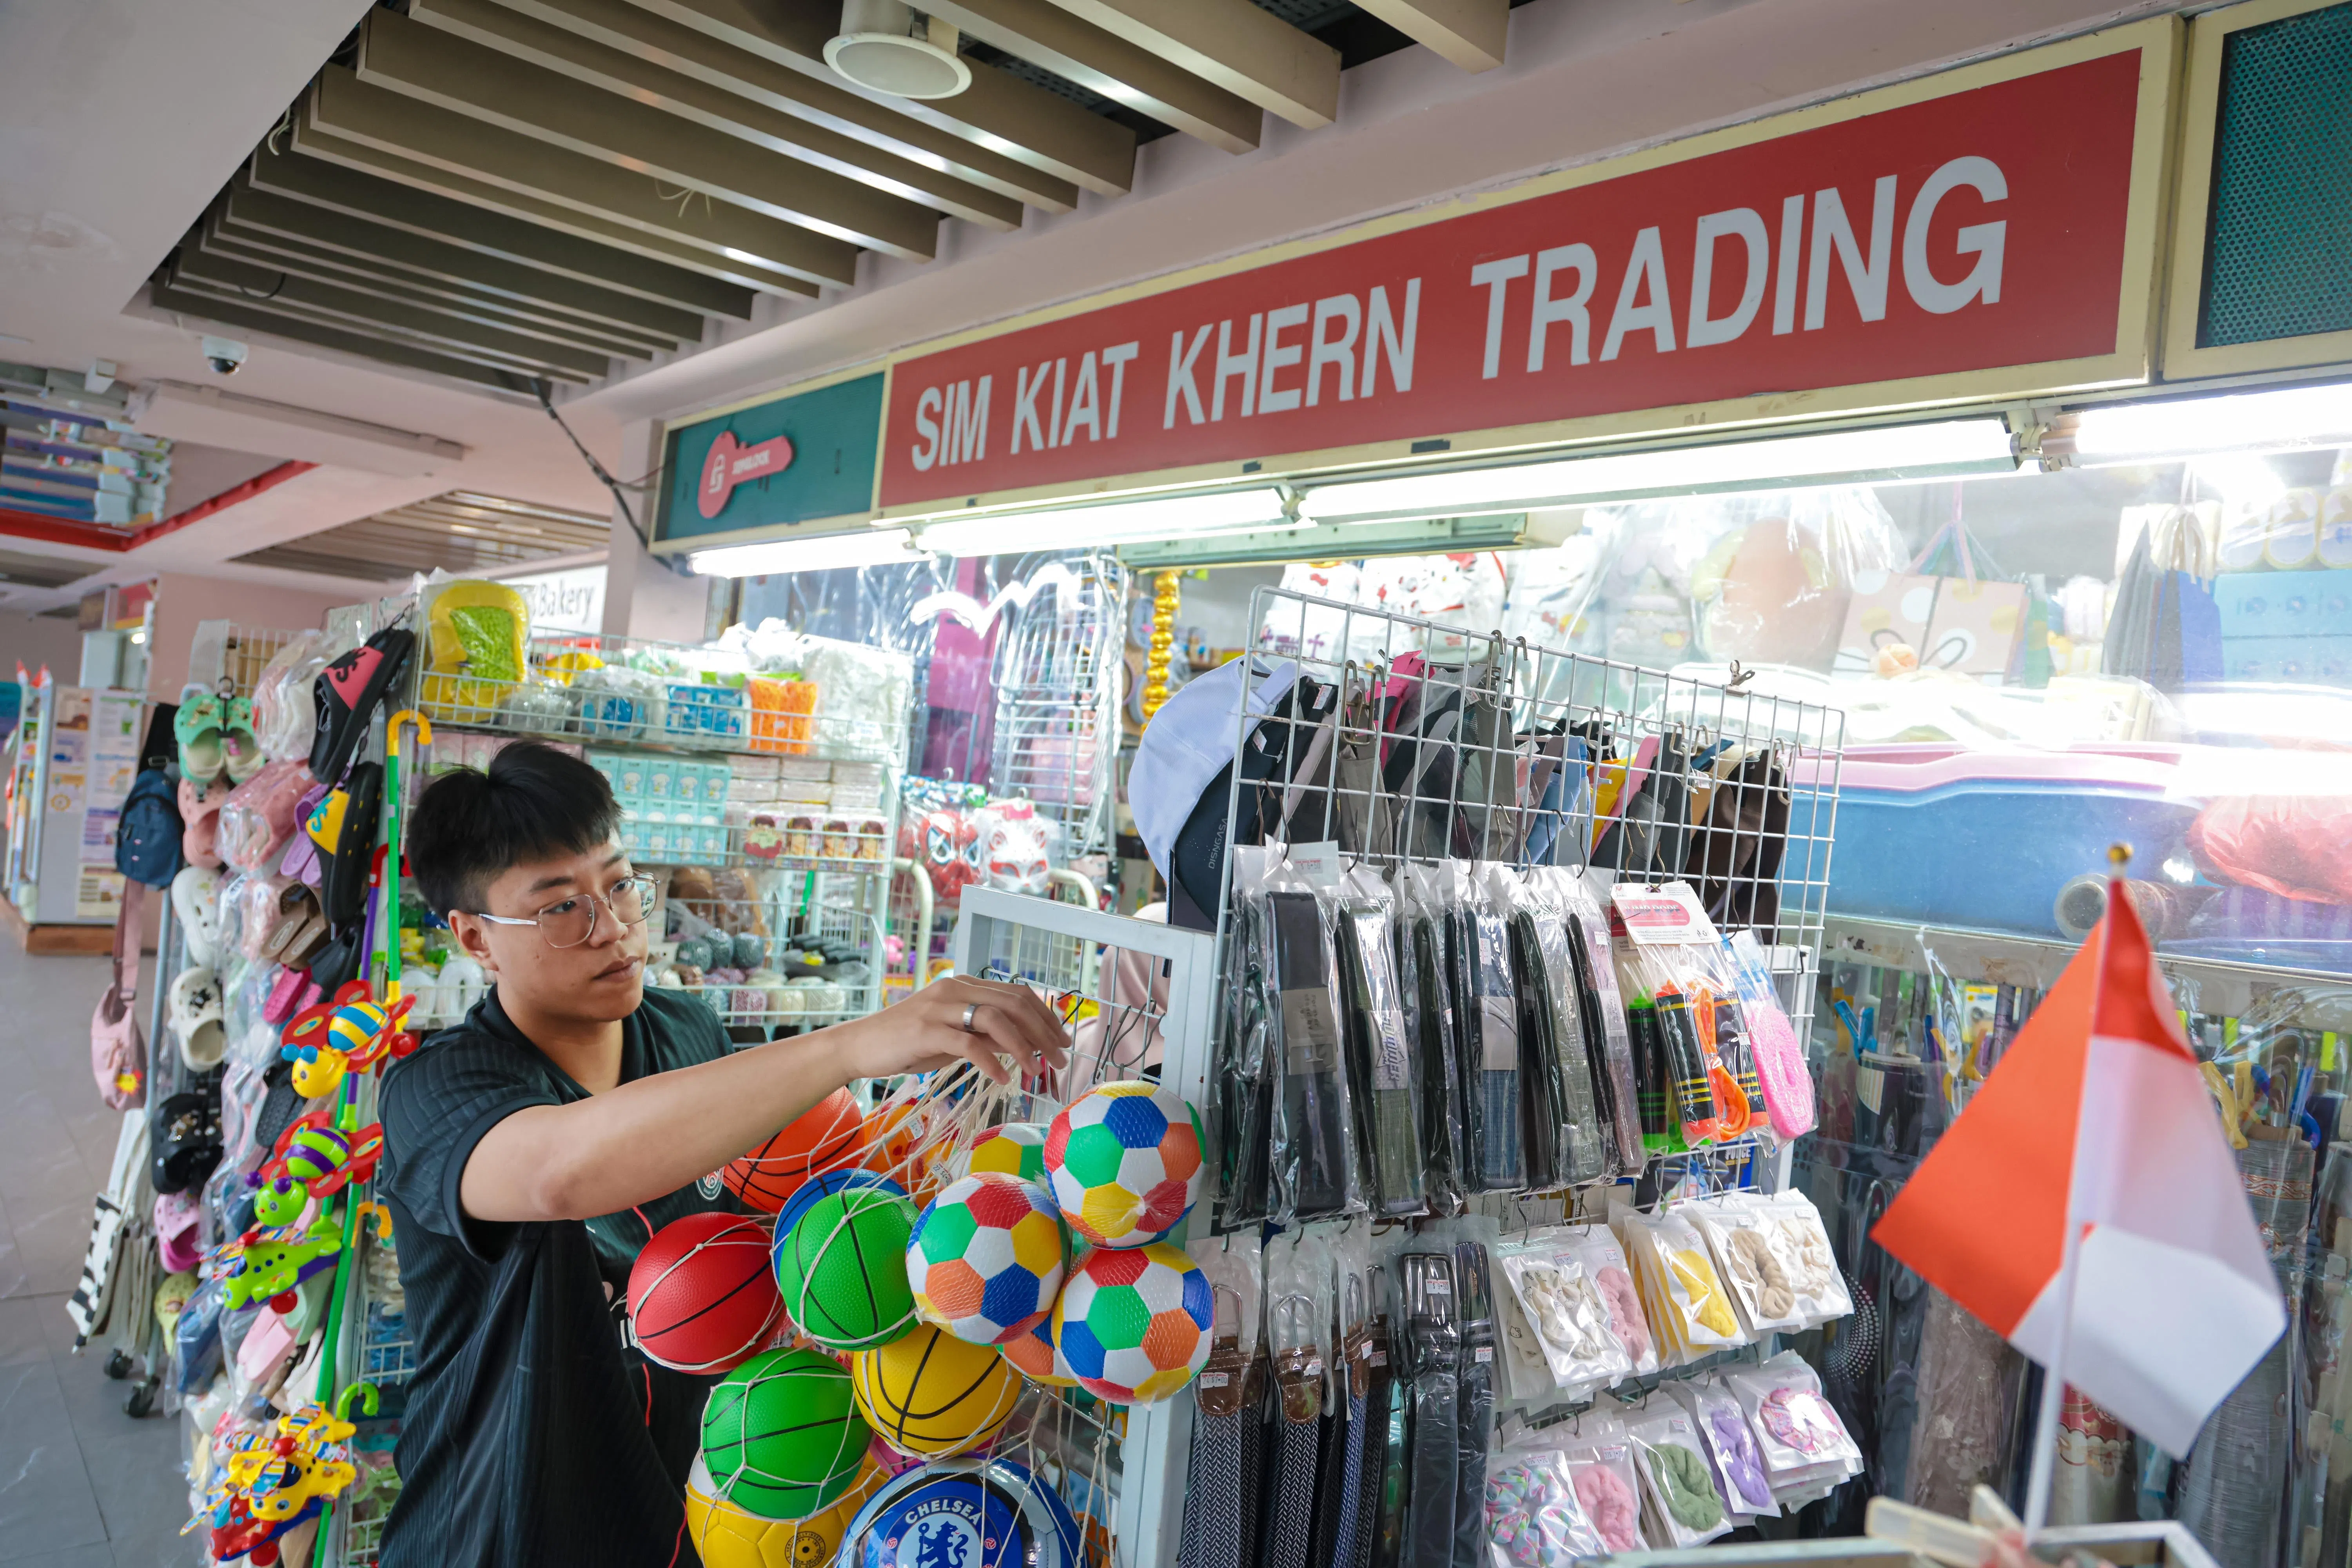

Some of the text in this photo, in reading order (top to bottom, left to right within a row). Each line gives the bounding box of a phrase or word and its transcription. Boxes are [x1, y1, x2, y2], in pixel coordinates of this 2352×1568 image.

[913, 156, 2008, 471] SIM KIAT KHERN TRADING
[539, 578, 596, 624] Bakery
[1724, 1147, 1751, 1160] POLCE
[906, 1499, 982, 1525] CHELSEA
